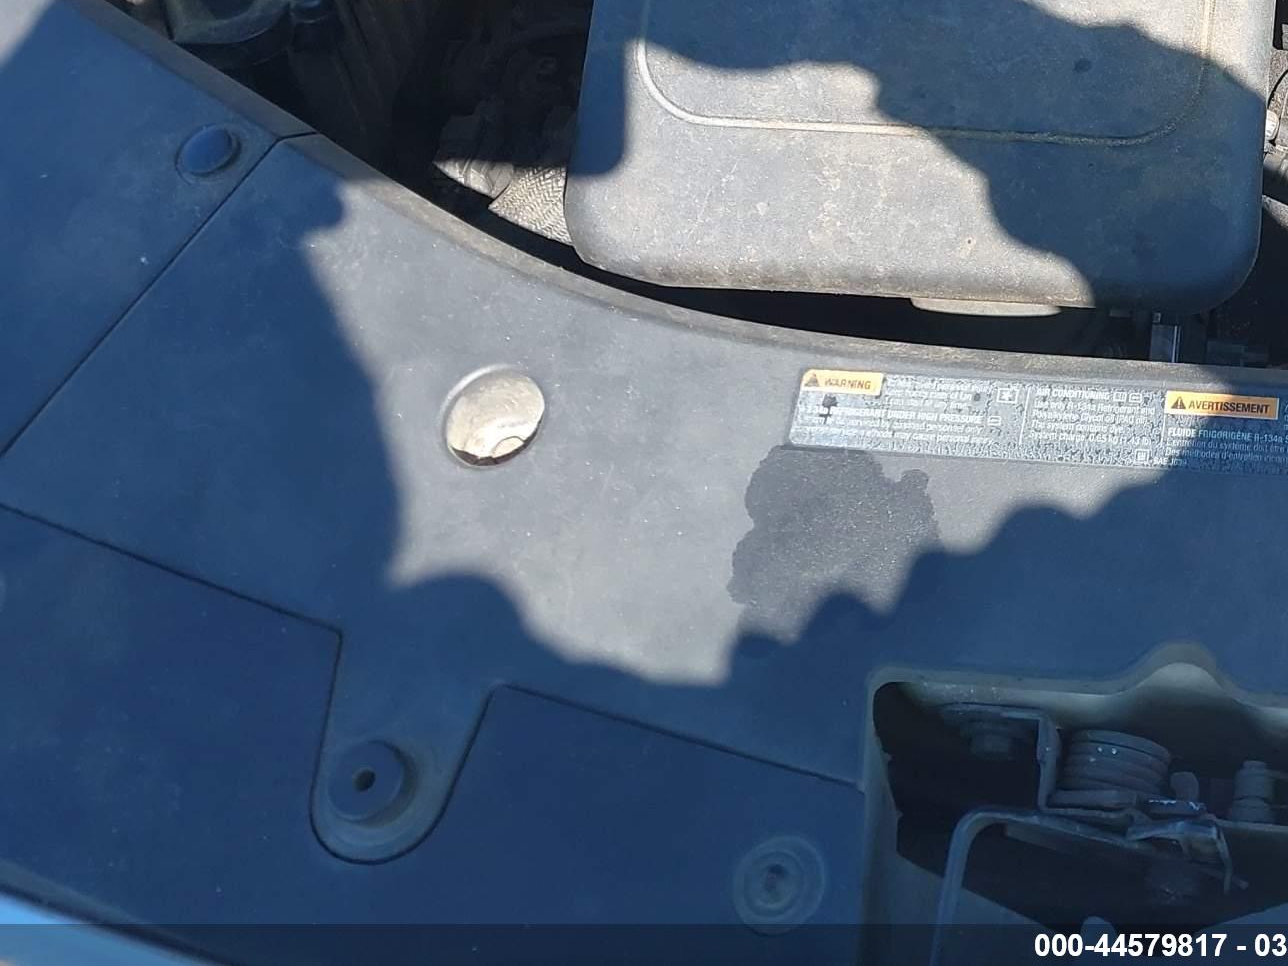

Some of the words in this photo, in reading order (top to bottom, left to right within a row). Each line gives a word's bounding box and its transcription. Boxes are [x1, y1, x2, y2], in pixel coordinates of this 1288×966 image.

[824, 377, 871, 389] WARNING
[1036, 387, 1050, 396] AIR
[1052, 388, 1109, 400] CONDITIONING
[1097, 403, 1138, 415] Refrigerant
[1188, 399, 1270, 414] AVERTISSEMENT
[886, 409, 914, 419] UNDER
[917, 411, 936, 421] HIGH
[938, 413, 982, 424] PRESSURE
[1031, 419, 1045, 428] The
[1046, 420, 1074, 432] system
[1030, 429, 1057, 440] System
[1168, 427, 1196, 437] FLUIDE
[1198, 427, 1252, 441] FRIGORIGÈNE
[1254, 432, 1282, 443] R-134a
[1165, 447, 1179, 456] Des
[1207, 441, 1218, 450] du
[1219, 442, 1252, 453] système
[1153, 456, 1168, 465] SAE
